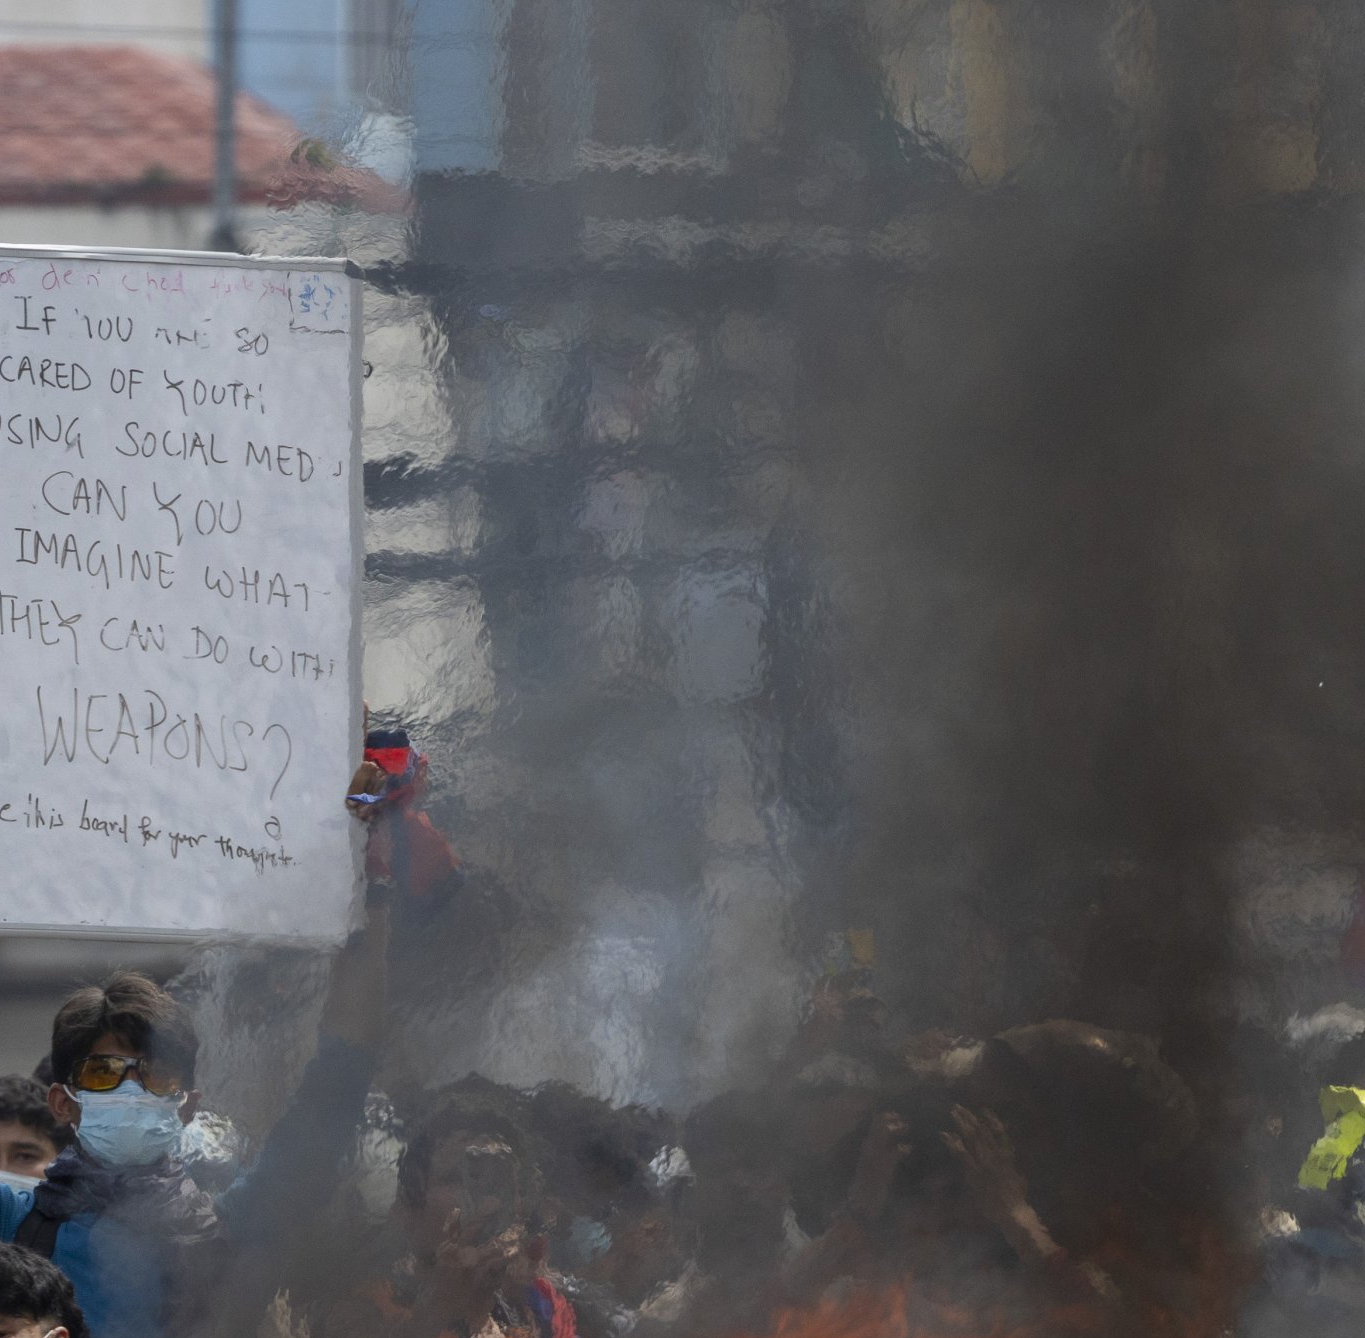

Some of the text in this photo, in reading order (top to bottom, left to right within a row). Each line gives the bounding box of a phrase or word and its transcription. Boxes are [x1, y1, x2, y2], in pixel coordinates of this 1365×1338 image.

[15, 296, 57, 331] IF
[110, 367, 144, 399] OF
[115, 422, 228, 466] SOCIAL
[41, 470, 243, 546] CAN YOU
[15, 527, 331, 612] IMAGINE WHAT
[99, 617, 165, 652] CAN
[183, 625, 229, 665] DO
